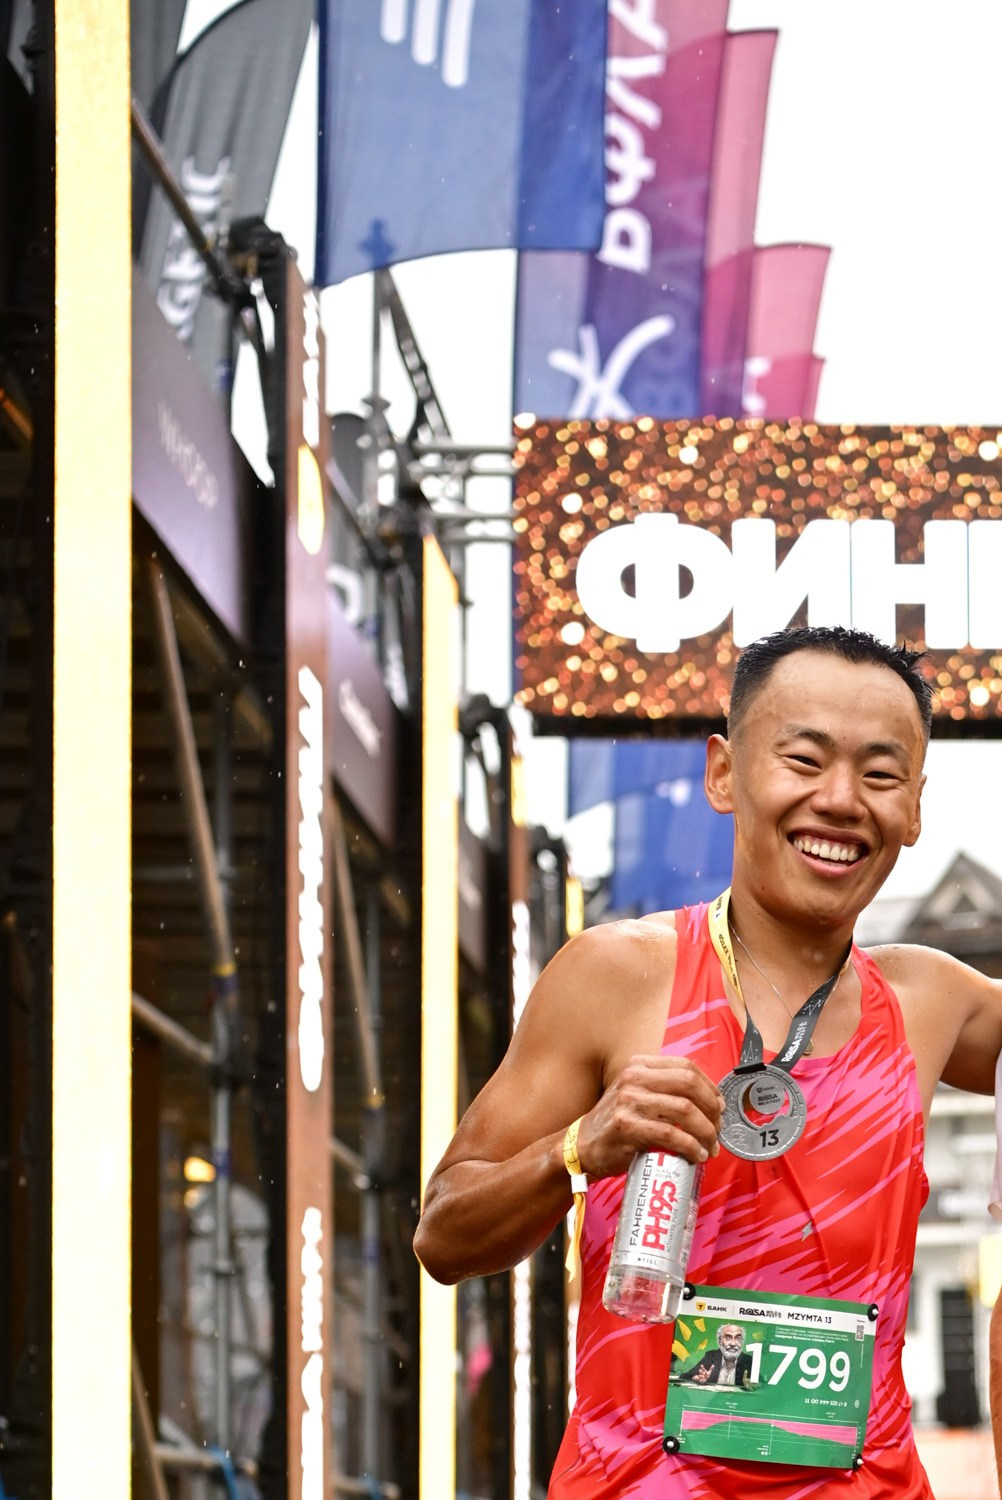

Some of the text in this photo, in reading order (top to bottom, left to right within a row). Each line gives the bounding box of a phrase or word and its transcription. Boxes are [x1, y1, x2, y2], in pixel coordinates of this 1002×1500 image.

[759, 1128, 780, 1148] 13
[630, 1154, 655, 1246] FAHRENHEIT
[787, 1312, 832, 1324] MZYMTA 13
[746, 1342, 851, 1392] 1799
